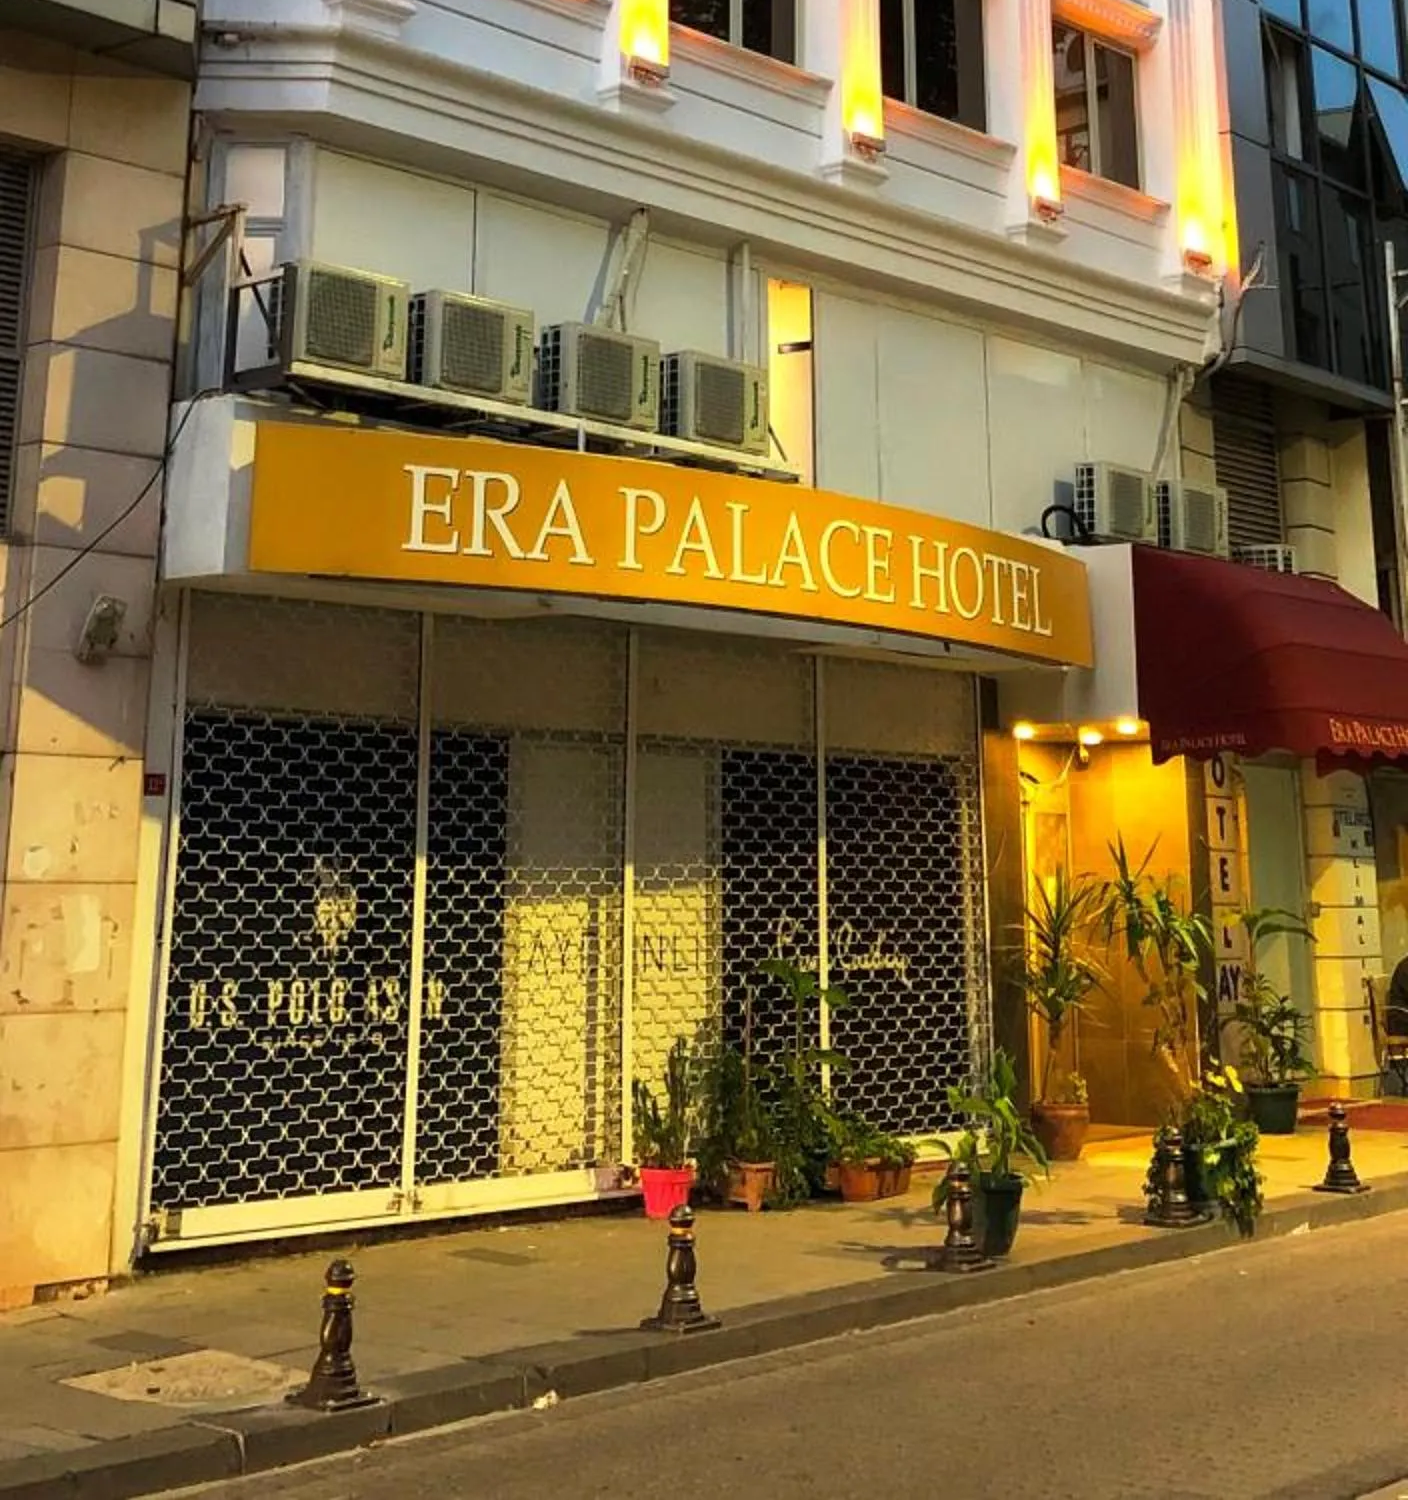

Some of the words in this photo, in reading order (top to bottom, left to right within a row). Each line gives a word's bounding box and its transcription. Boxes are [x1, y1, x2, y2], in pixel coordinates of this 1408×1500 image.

[402, 463, 595, 566] ERA
[618, 486, 896, 604] PALACE
[908, 534, 1053, 637] HOTEL
[1329, 718, 1355, 743] ERA
[267, 978, 347, 1026] POLO
[364, 976, 445, 1022] ASN
